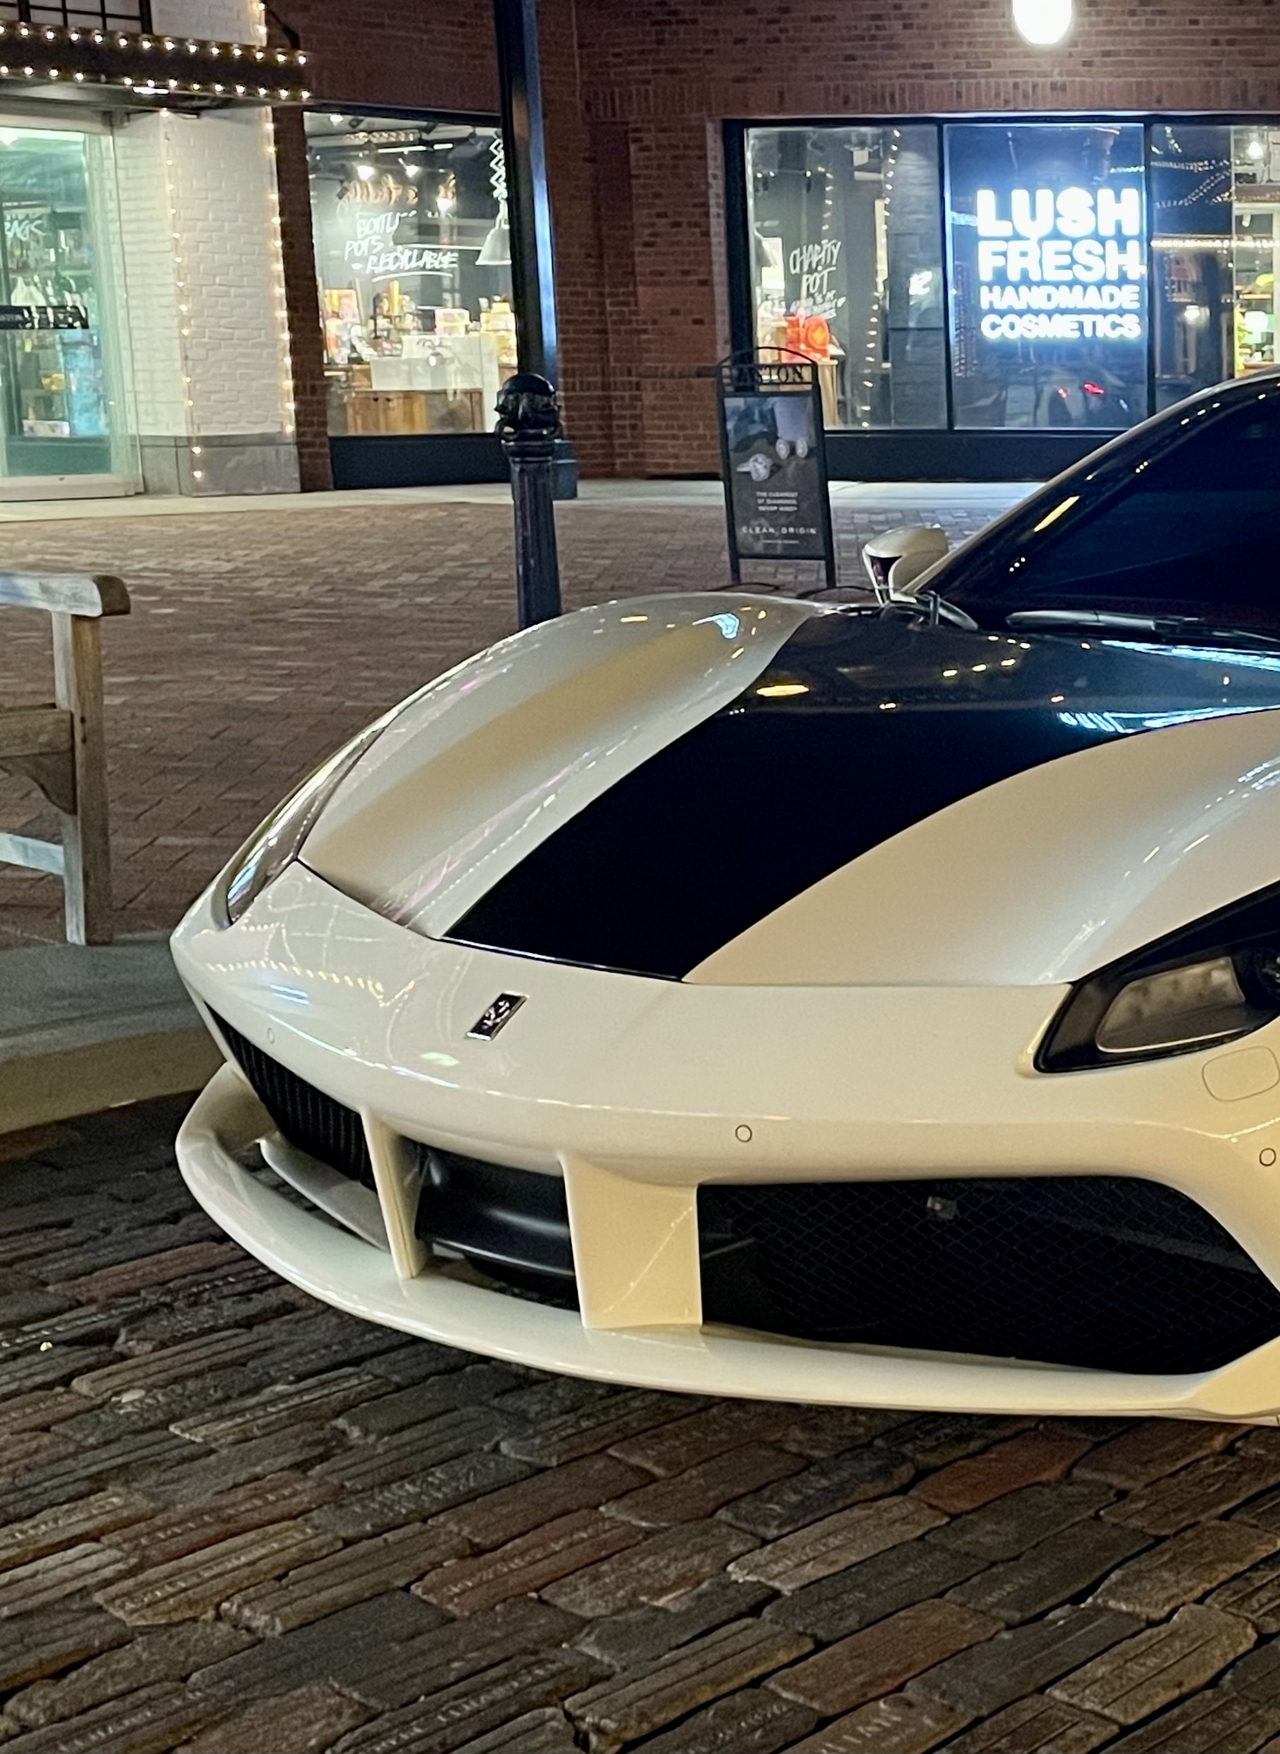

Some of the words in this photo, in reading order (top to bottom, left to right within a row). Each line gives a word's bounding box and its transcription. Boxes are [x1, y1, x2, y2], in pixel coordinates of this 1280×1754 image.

[976, 186, 1141, 238] LUSH
[789, 239, 842, 275] CHARITY
[977, 239, 1142, 282] FRESH
[802, 266, 837, 295] POT
[980, 285, 1141, 310] HANDMADE
[980, 313, 1142, 339] COSMETICS
